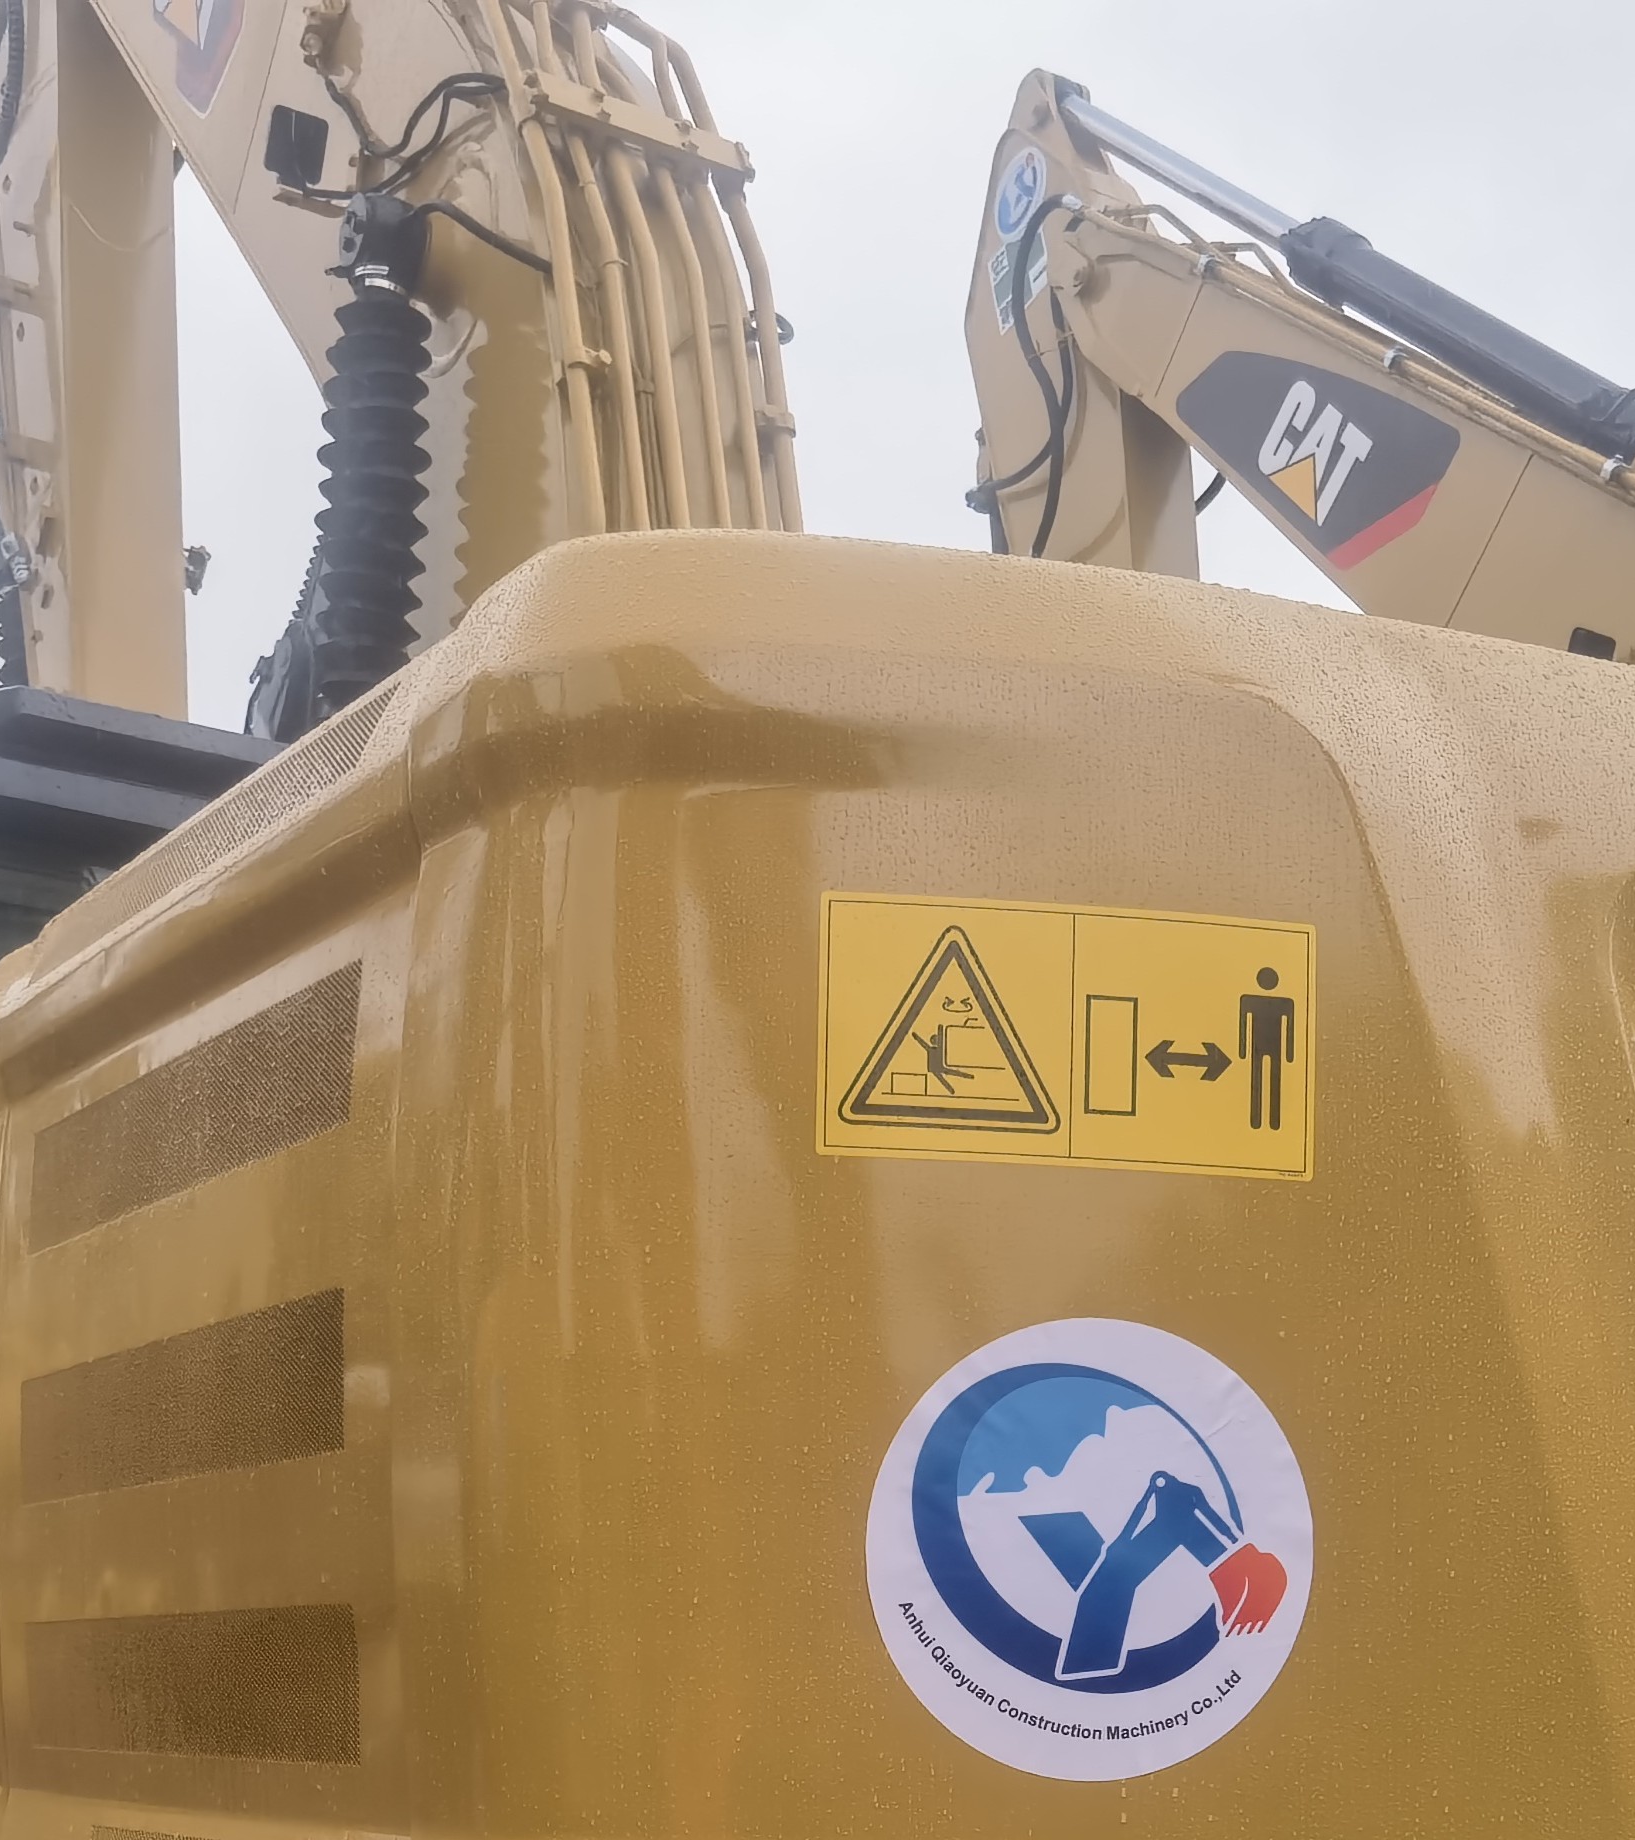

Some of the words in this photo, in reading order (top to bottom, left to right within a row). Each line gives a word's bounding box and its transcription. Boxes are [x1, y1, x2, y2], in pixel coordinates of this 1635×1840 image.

[1258, 380, 1373, 527] CAT
[898, 1602, 936, 1648] Anhui
[931, 1645, 995, 1706] Qiaoyuan
[997, 1699, 1102, 1740] Construction
[1106, 1710, 1189, 1740] Machinery
